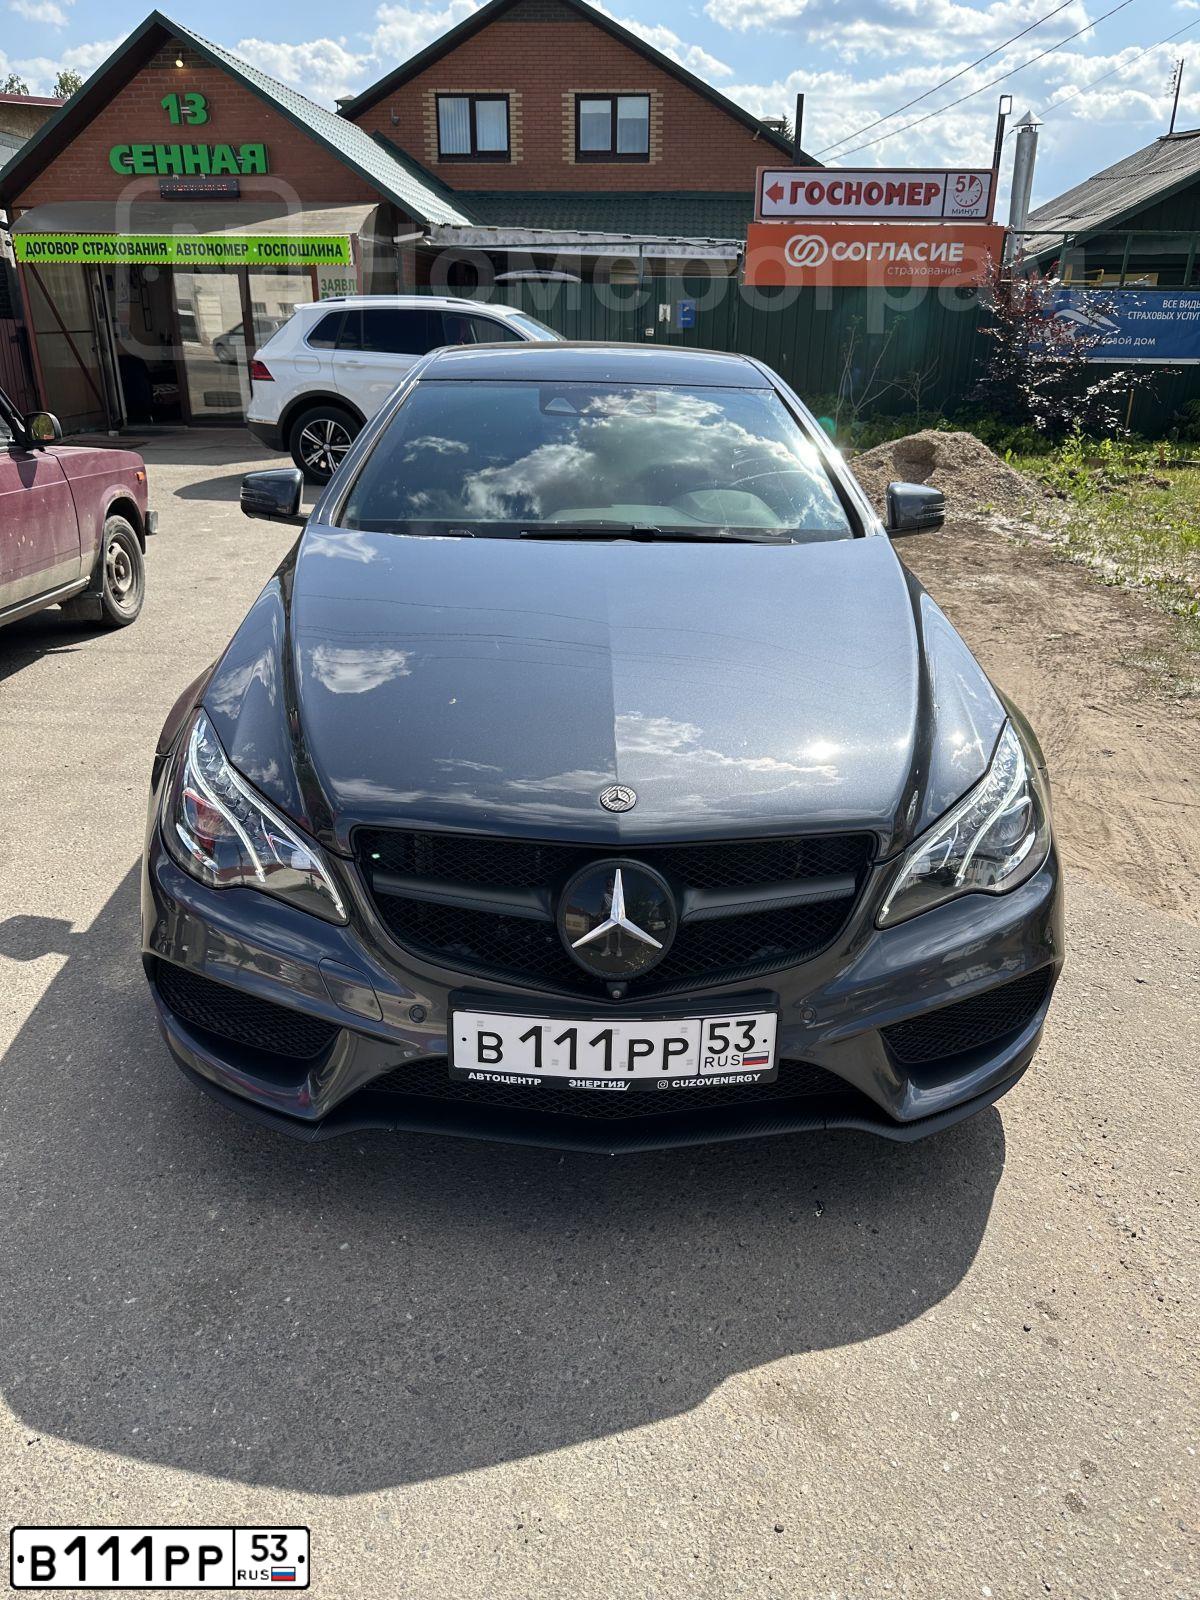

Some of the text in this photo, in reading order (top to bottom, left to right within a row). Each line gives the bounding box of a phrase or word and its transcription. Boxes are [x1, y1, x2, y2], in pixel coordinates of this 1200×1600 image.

[160, 92, 208, 126] 13
[108, 143, 268, 175] СЕННАЯ
[955, 175, 966, 193] 5
[789, 181, 941, 206] ГОСНОМЕР
[951, 207, 979, 216] минут
[26, 241, 343, 257] ДОГОВОР СТРАХОВАНИЯ АВТОНОМЕР ГОСПОШЛИНА
[832, 241, 965, 262] СОГЛАСИЕ
[887, 267, 962, 277] страхование
[1162, 299, 1178, 308] ВСЕ
[1127, 311, 1174, 320] СТРАХОВЫХ
[1133, 337, 1156, 346] ДОМ
[707, 1020, 756, 1054] 53
[703, 1054, 741, 1069] RUS
[467, 1072, 625, 1088] АВТОЦЕНТР ЭНЕРГИЯ
[671, 1073, 761, 1088] CUZOVENERGY
